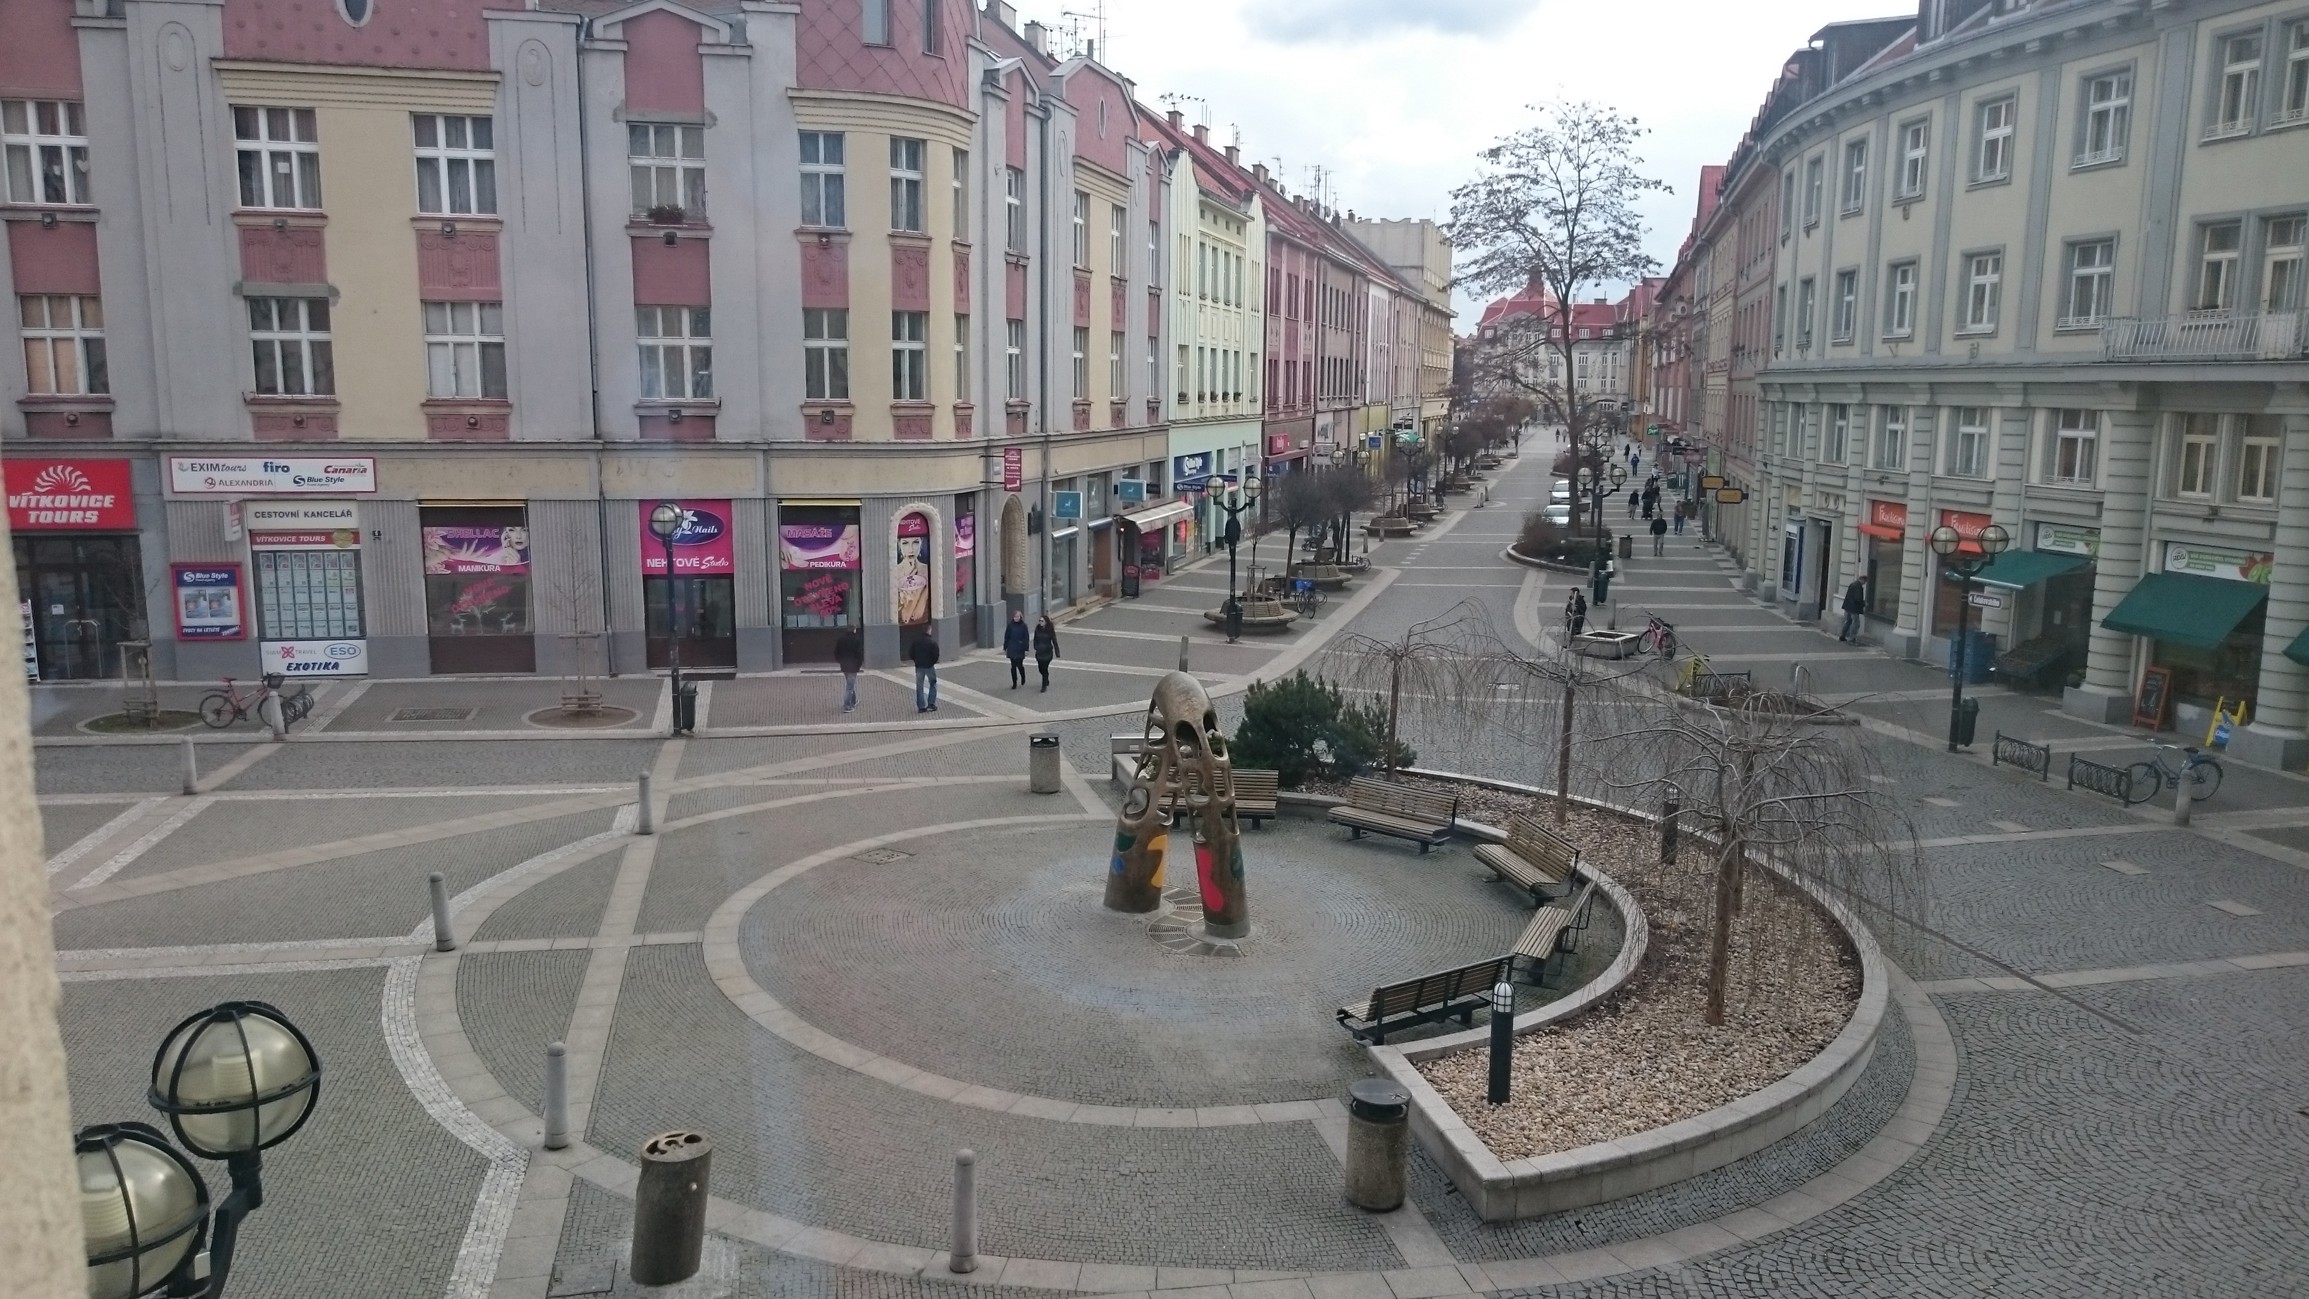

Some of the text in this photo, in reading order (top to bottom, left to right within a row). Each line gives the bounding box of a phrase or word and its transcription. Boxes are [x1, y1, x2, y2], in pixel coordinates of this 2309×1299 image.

[263, 461, 290, 473] firo
[323, 465, 367, 474] Canaria
[325, 476, 345, 485] Style
[9, 491, 115, 508] VÍTKOVICE
[28, 510, 99, 524] TOURS
[254, 508, 352, 519] CESTOVNÍ KANCELÁŘ
[446, 528, 500, 539] SHELLAC
[692, 525, 718, 534] Nails
[256, 534, 326, 543] VÍTKOVICE TOURS
[646, 556, 729, 569] NEHOVÉ Studio
[809, 560, 847, 568] PEDIKÚRA
[211, 572, 229, 580] Style
[330, 647, 357, 656] ESO
[286, 661, 340, 672] EXOTIKA
